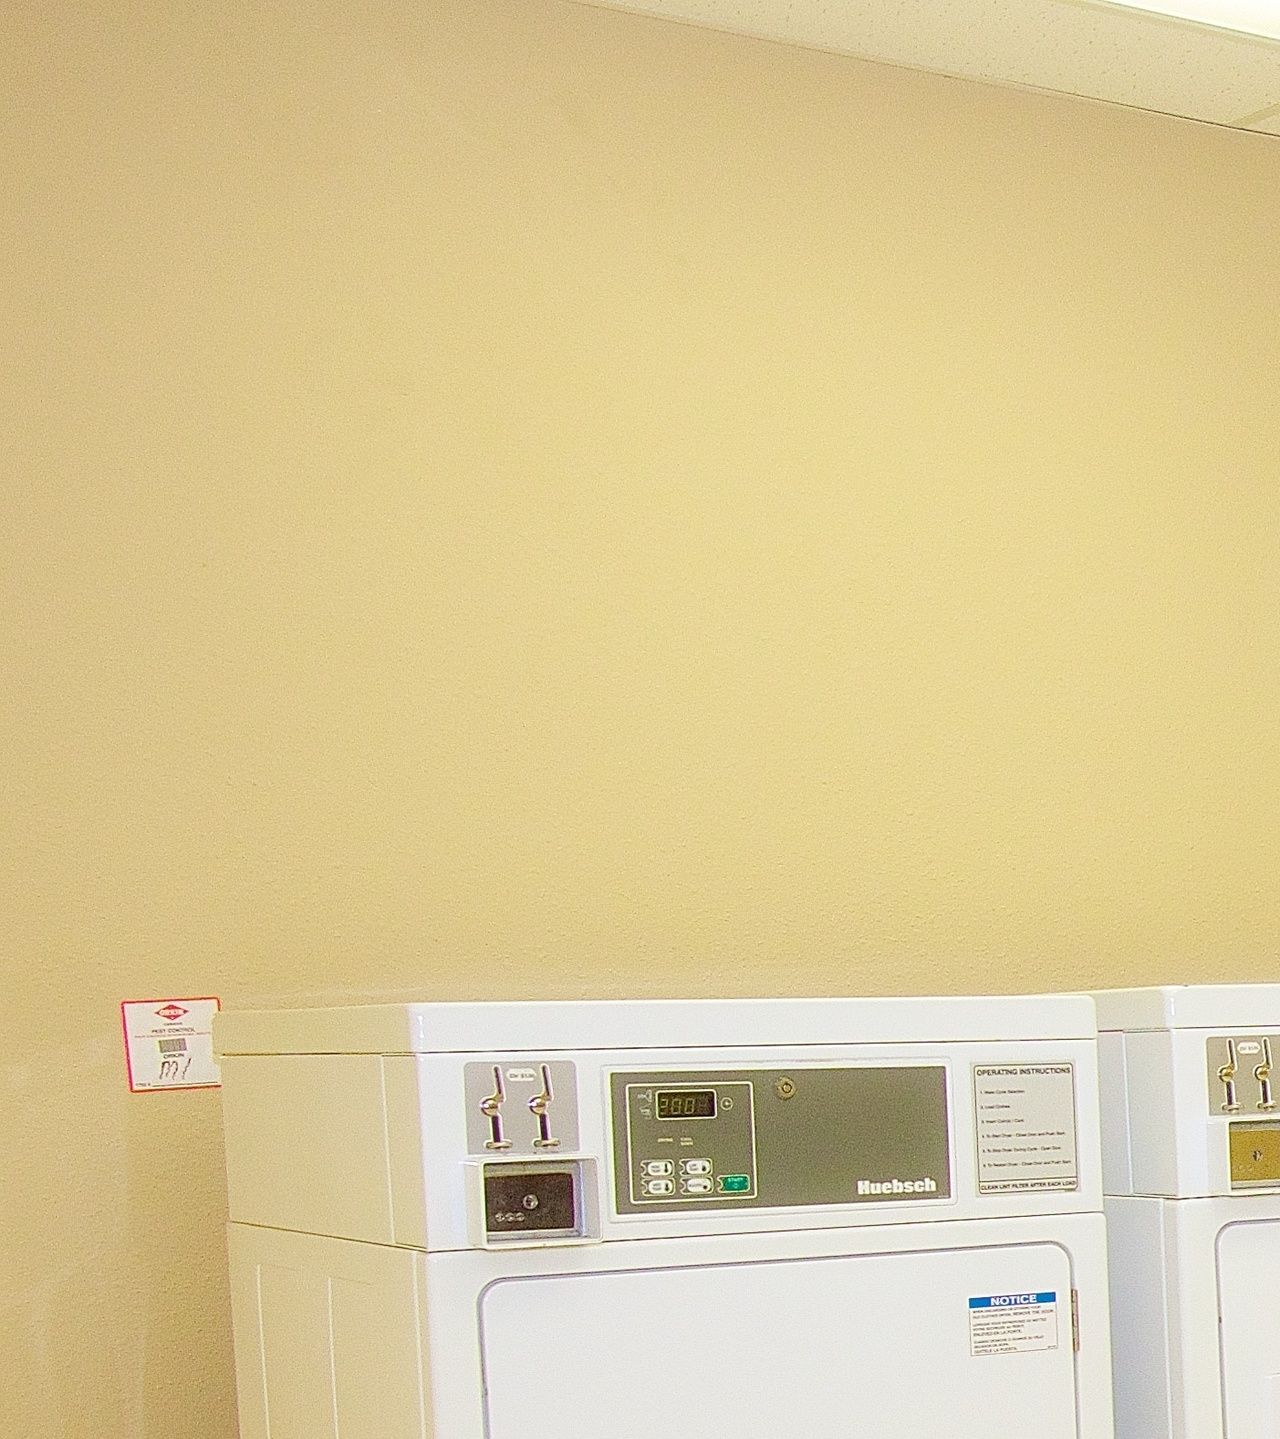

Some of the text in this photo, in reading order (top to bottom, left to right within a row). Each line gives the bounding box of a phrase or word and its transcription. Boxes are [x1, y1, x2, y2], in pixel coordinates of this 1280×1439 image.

[976, 1067, 1071, 1076] OPERATING INSTRUCTIONS
[857, 1177, 937, 1195] Huebsch
[990, 1294, 1038, 1306] NOTICE
